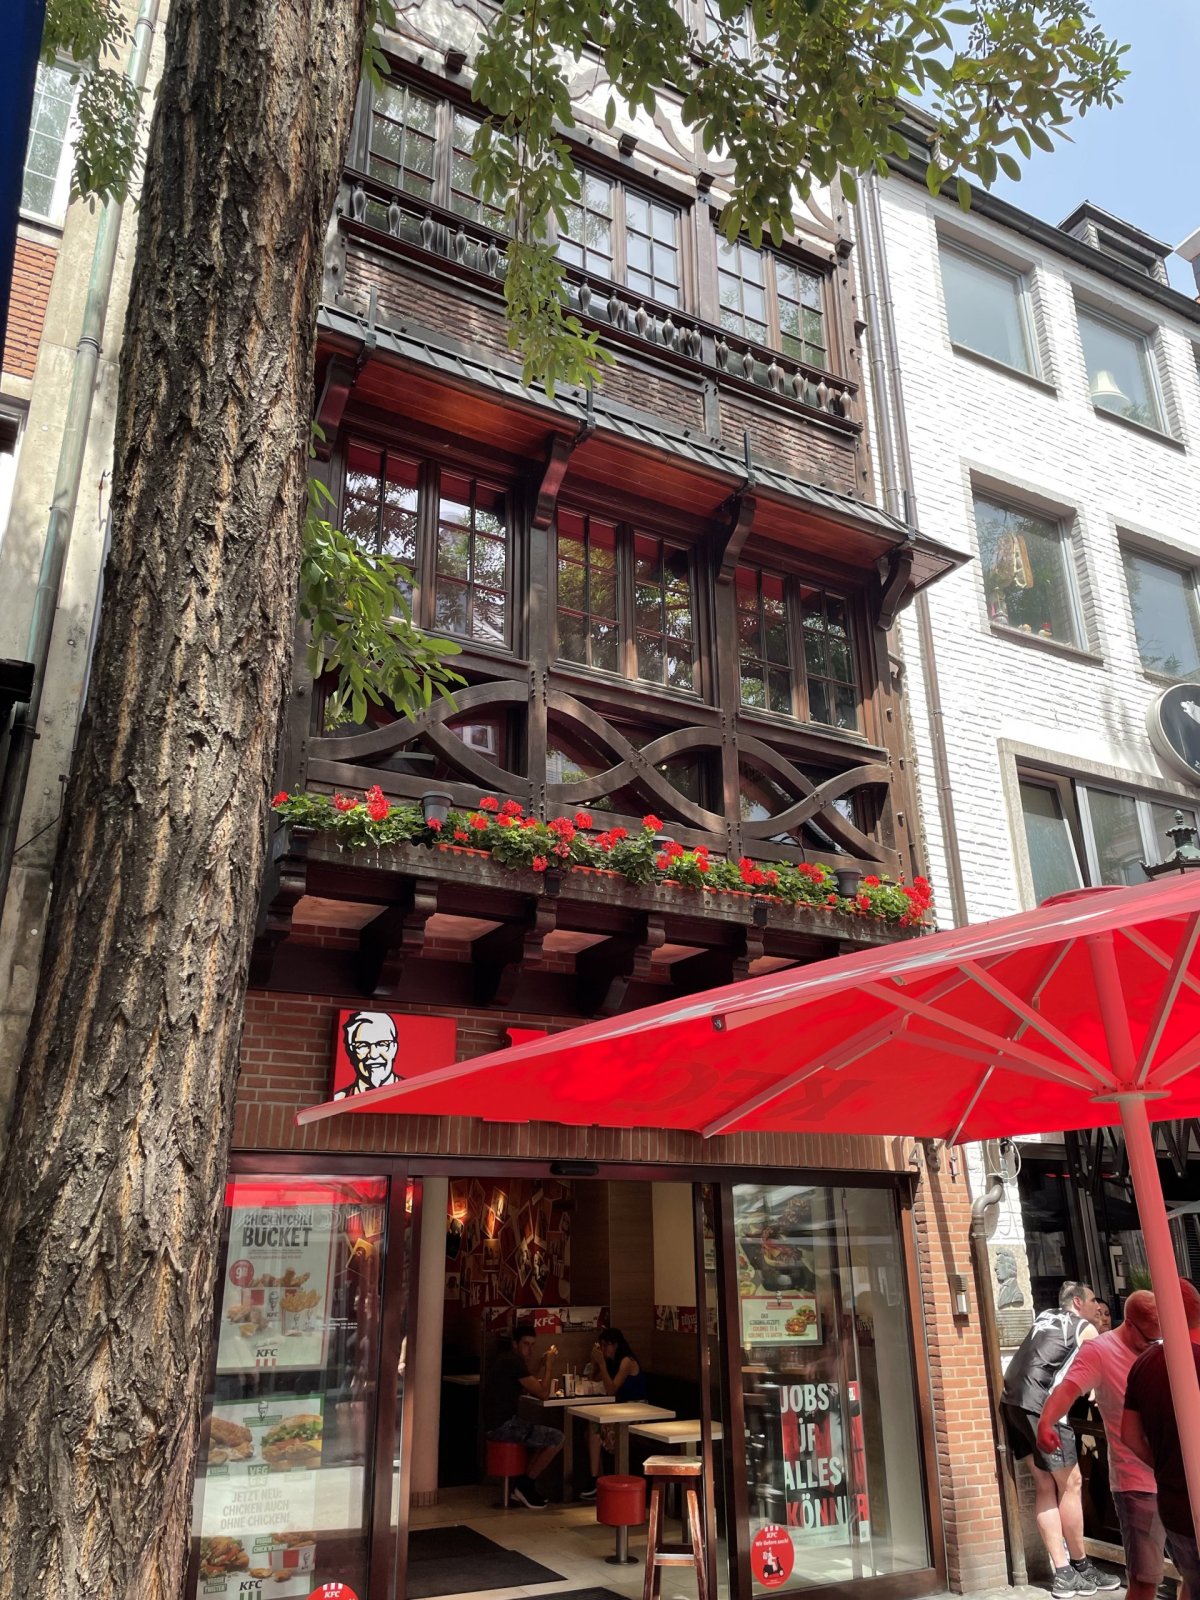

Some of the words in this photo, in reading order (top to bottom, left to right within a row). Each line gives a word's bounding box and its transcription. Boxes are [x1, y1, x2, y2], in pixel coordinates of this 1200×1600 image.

[908, 1142, 941, 1168] 48
[242, 1227, 312, 1247] BUCKET
[534, 1316, 556, 1328] KFC
[256, 1348, 278, 1358] KFC
[781, 1383, 829, 1413] JOBS
[784, 1457, 842, 1490] ALLES
[232, 1491, 260, 1503] JETZT
[261, 1488, 282, 1500] NEU:
[223, 1503, 262, 1517] CHICKEN
[264, 1500, 289, 1512] AUCH
[221, 1518, 247, 1530] OHNE
[247, 1513, 290, 1527] CHICKEN!
[239, 1580, 262, 1591] KFC
[324, 1590, 340, 1598] KFC
